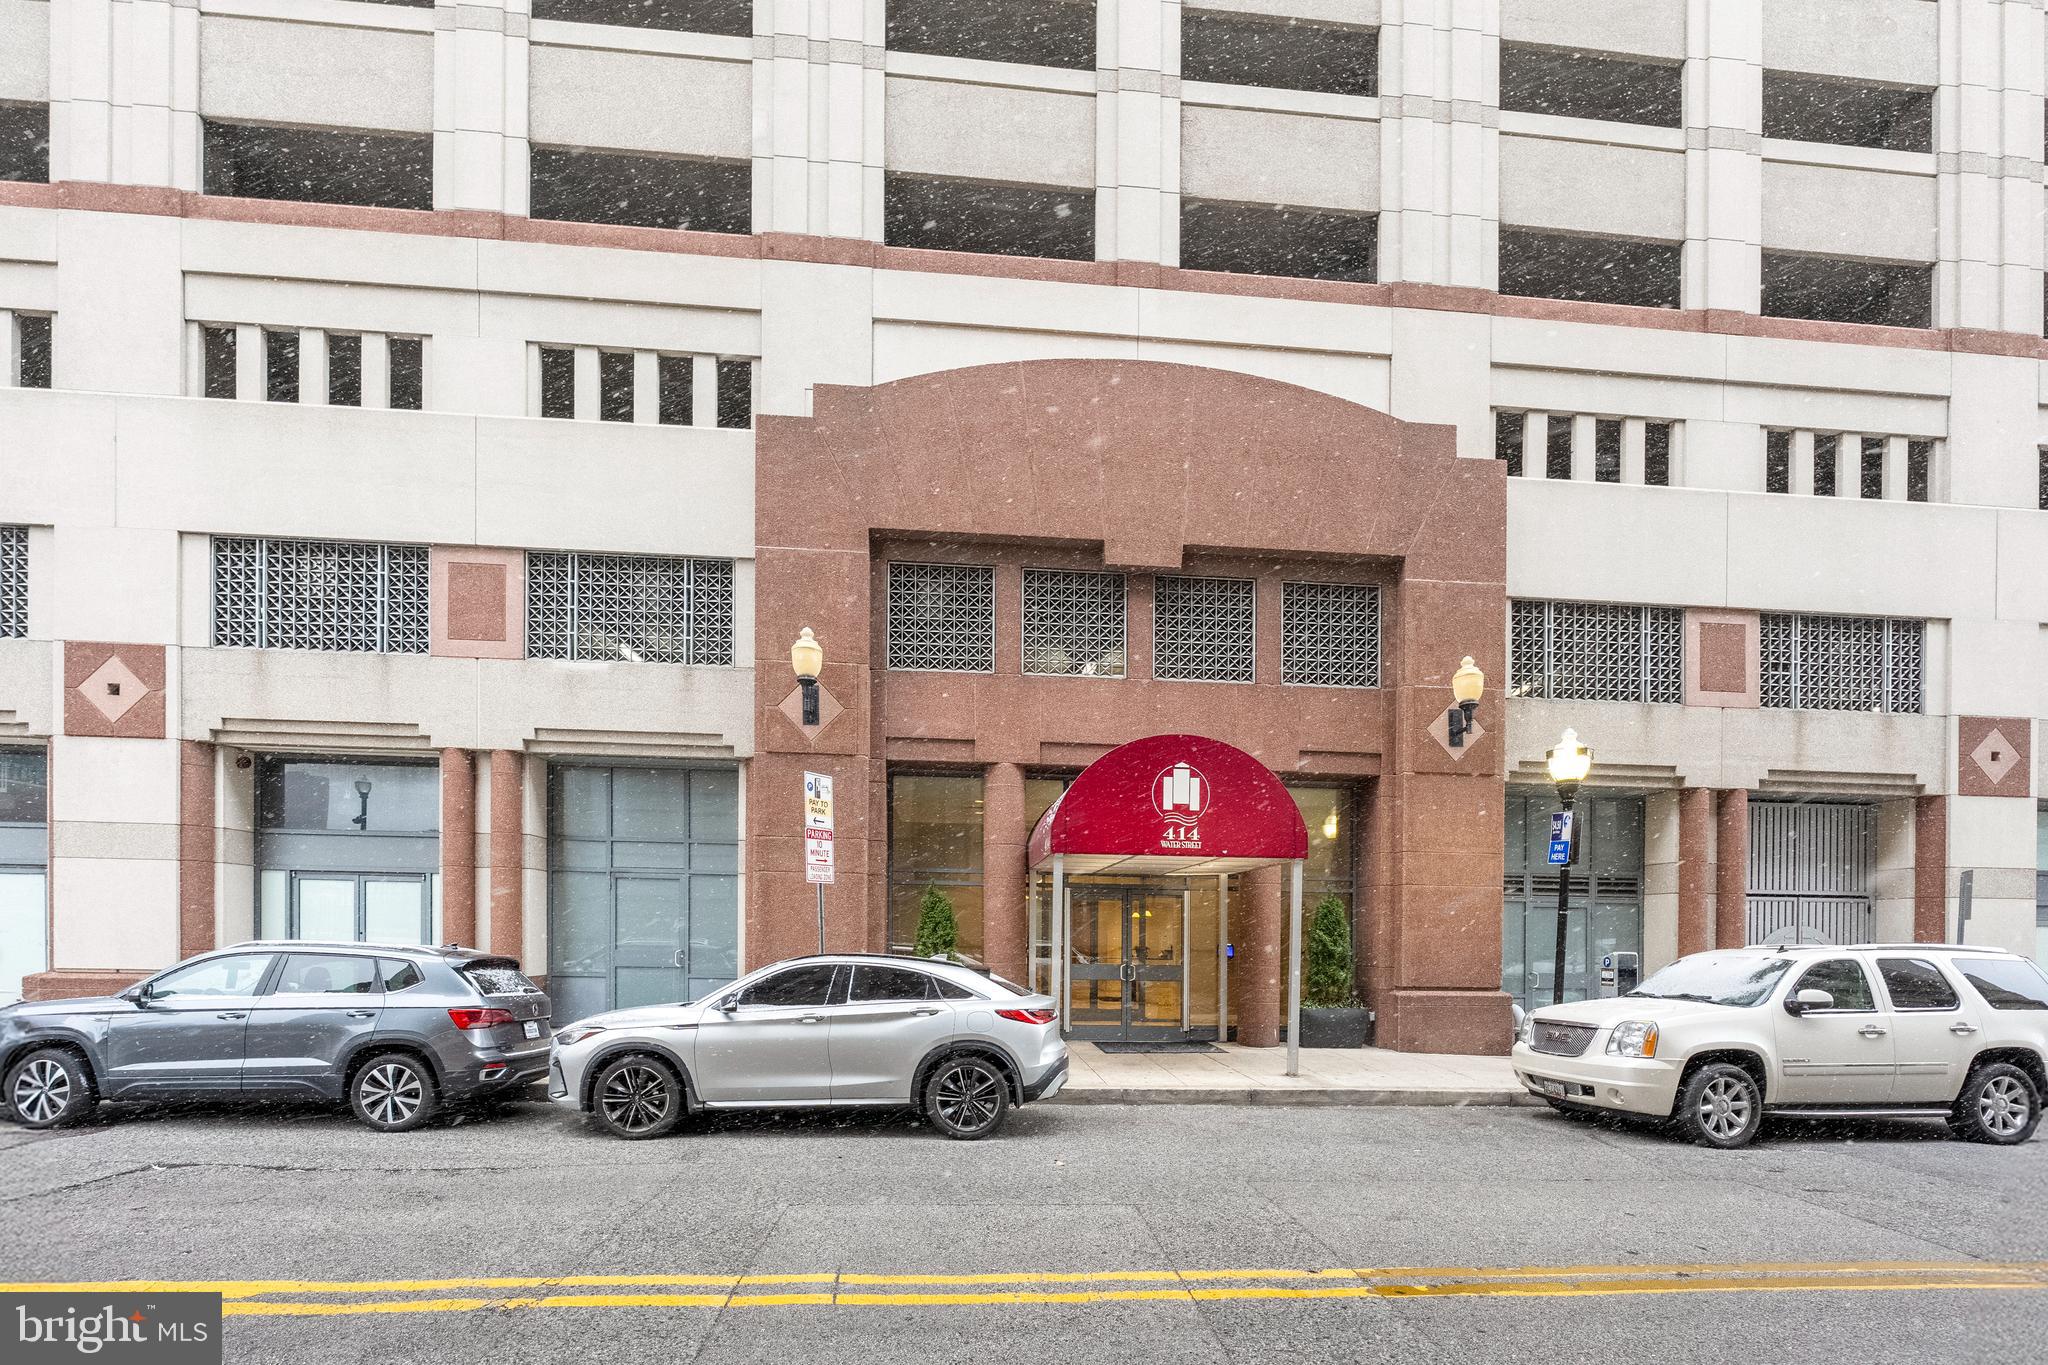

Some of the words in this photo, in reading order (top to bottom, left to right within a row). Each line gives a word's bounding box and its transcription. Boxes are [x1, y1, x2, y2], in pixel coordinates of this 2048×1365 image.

[808, 798, 819, 806] PAY
[821, 800, 829, 808] TO
[811, 806, 826, 815] PARK
[807, 829, 832, 841] PARKING
[1163, 826, 1200, 841] 414
[816, 840, 823, 848] 10
[1160, 840, 1181, 849] WATER
[1181, 841, 1202, 849] STREET
[1554, 844, 1565, 852] PAY
[810, 849, 830, 858] MINUTE
